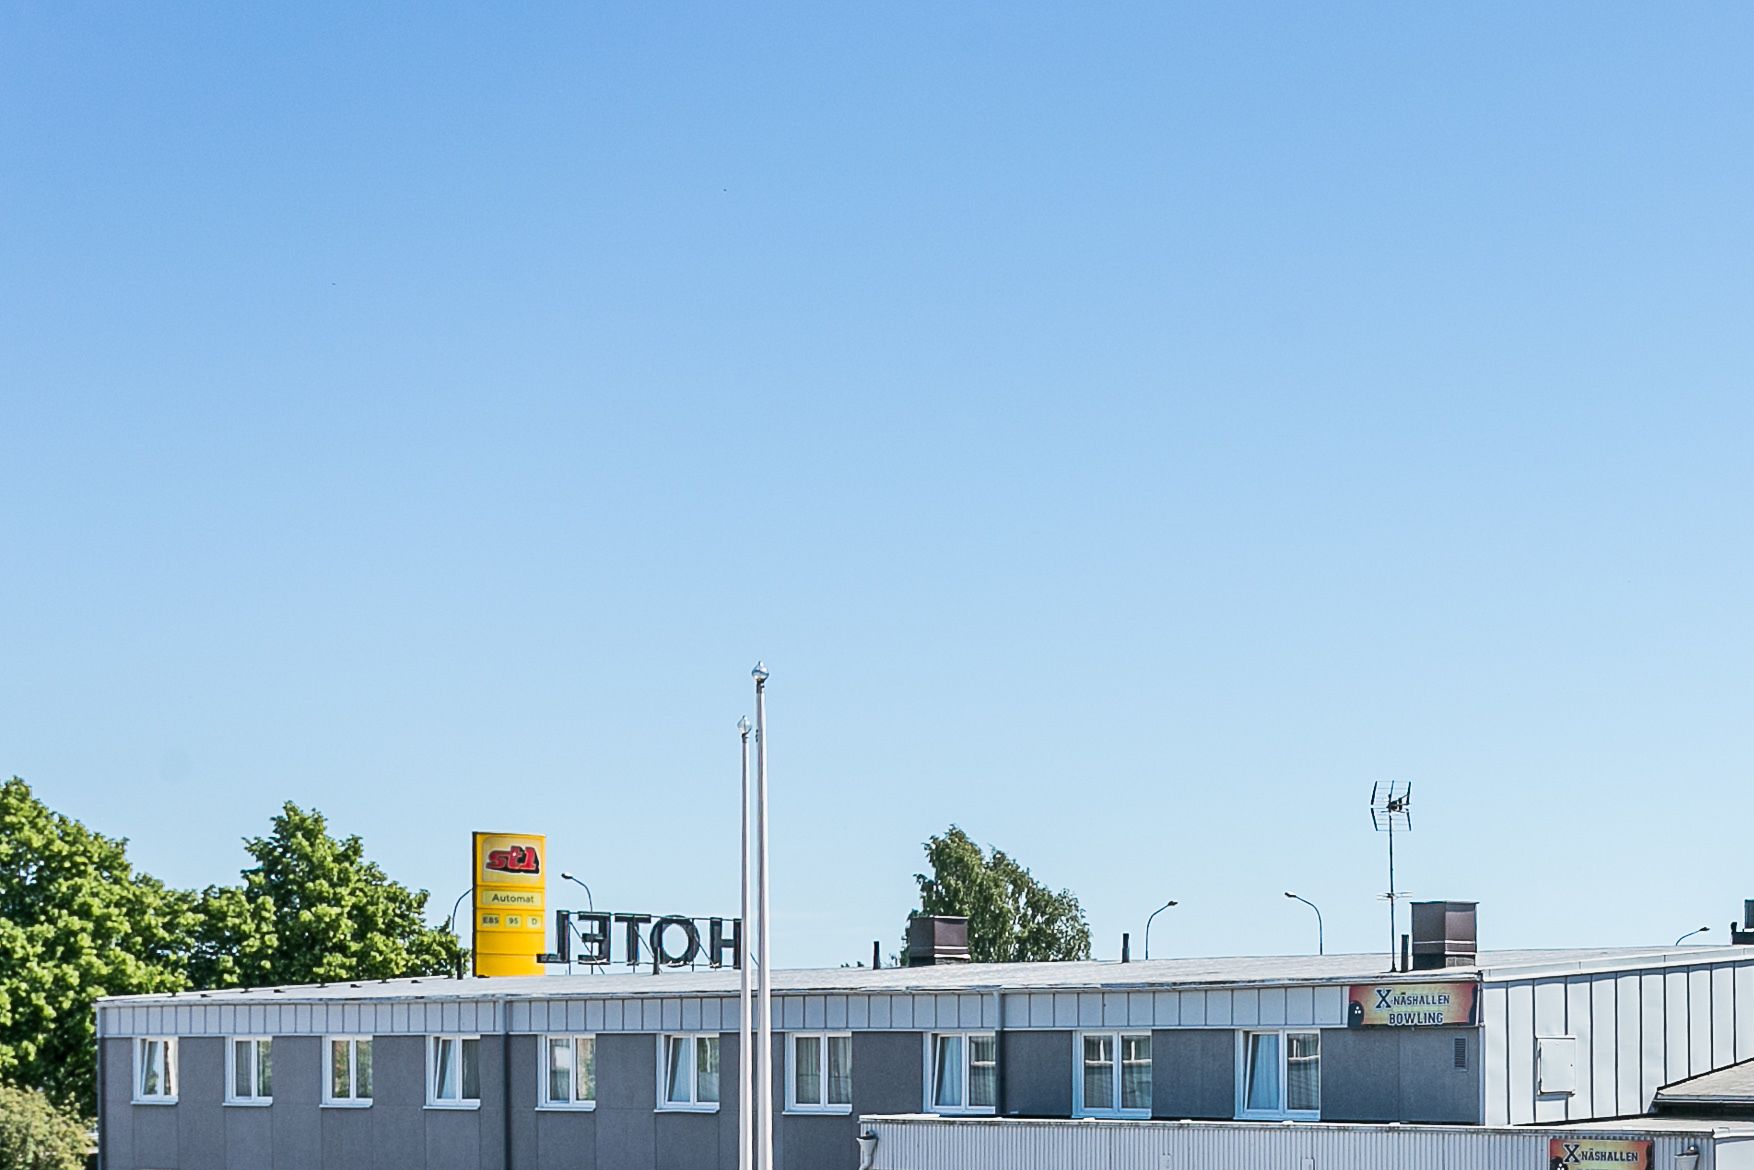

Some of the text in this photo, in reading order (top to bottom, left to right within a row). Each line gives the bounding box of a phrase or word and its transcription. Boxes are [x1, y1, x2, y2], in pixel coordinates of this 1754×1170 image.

[491, 893, 534, 903] Automat
[482, 916, 499, 924] E85
[1389, 1012, 1443, 1024] BOWLING
